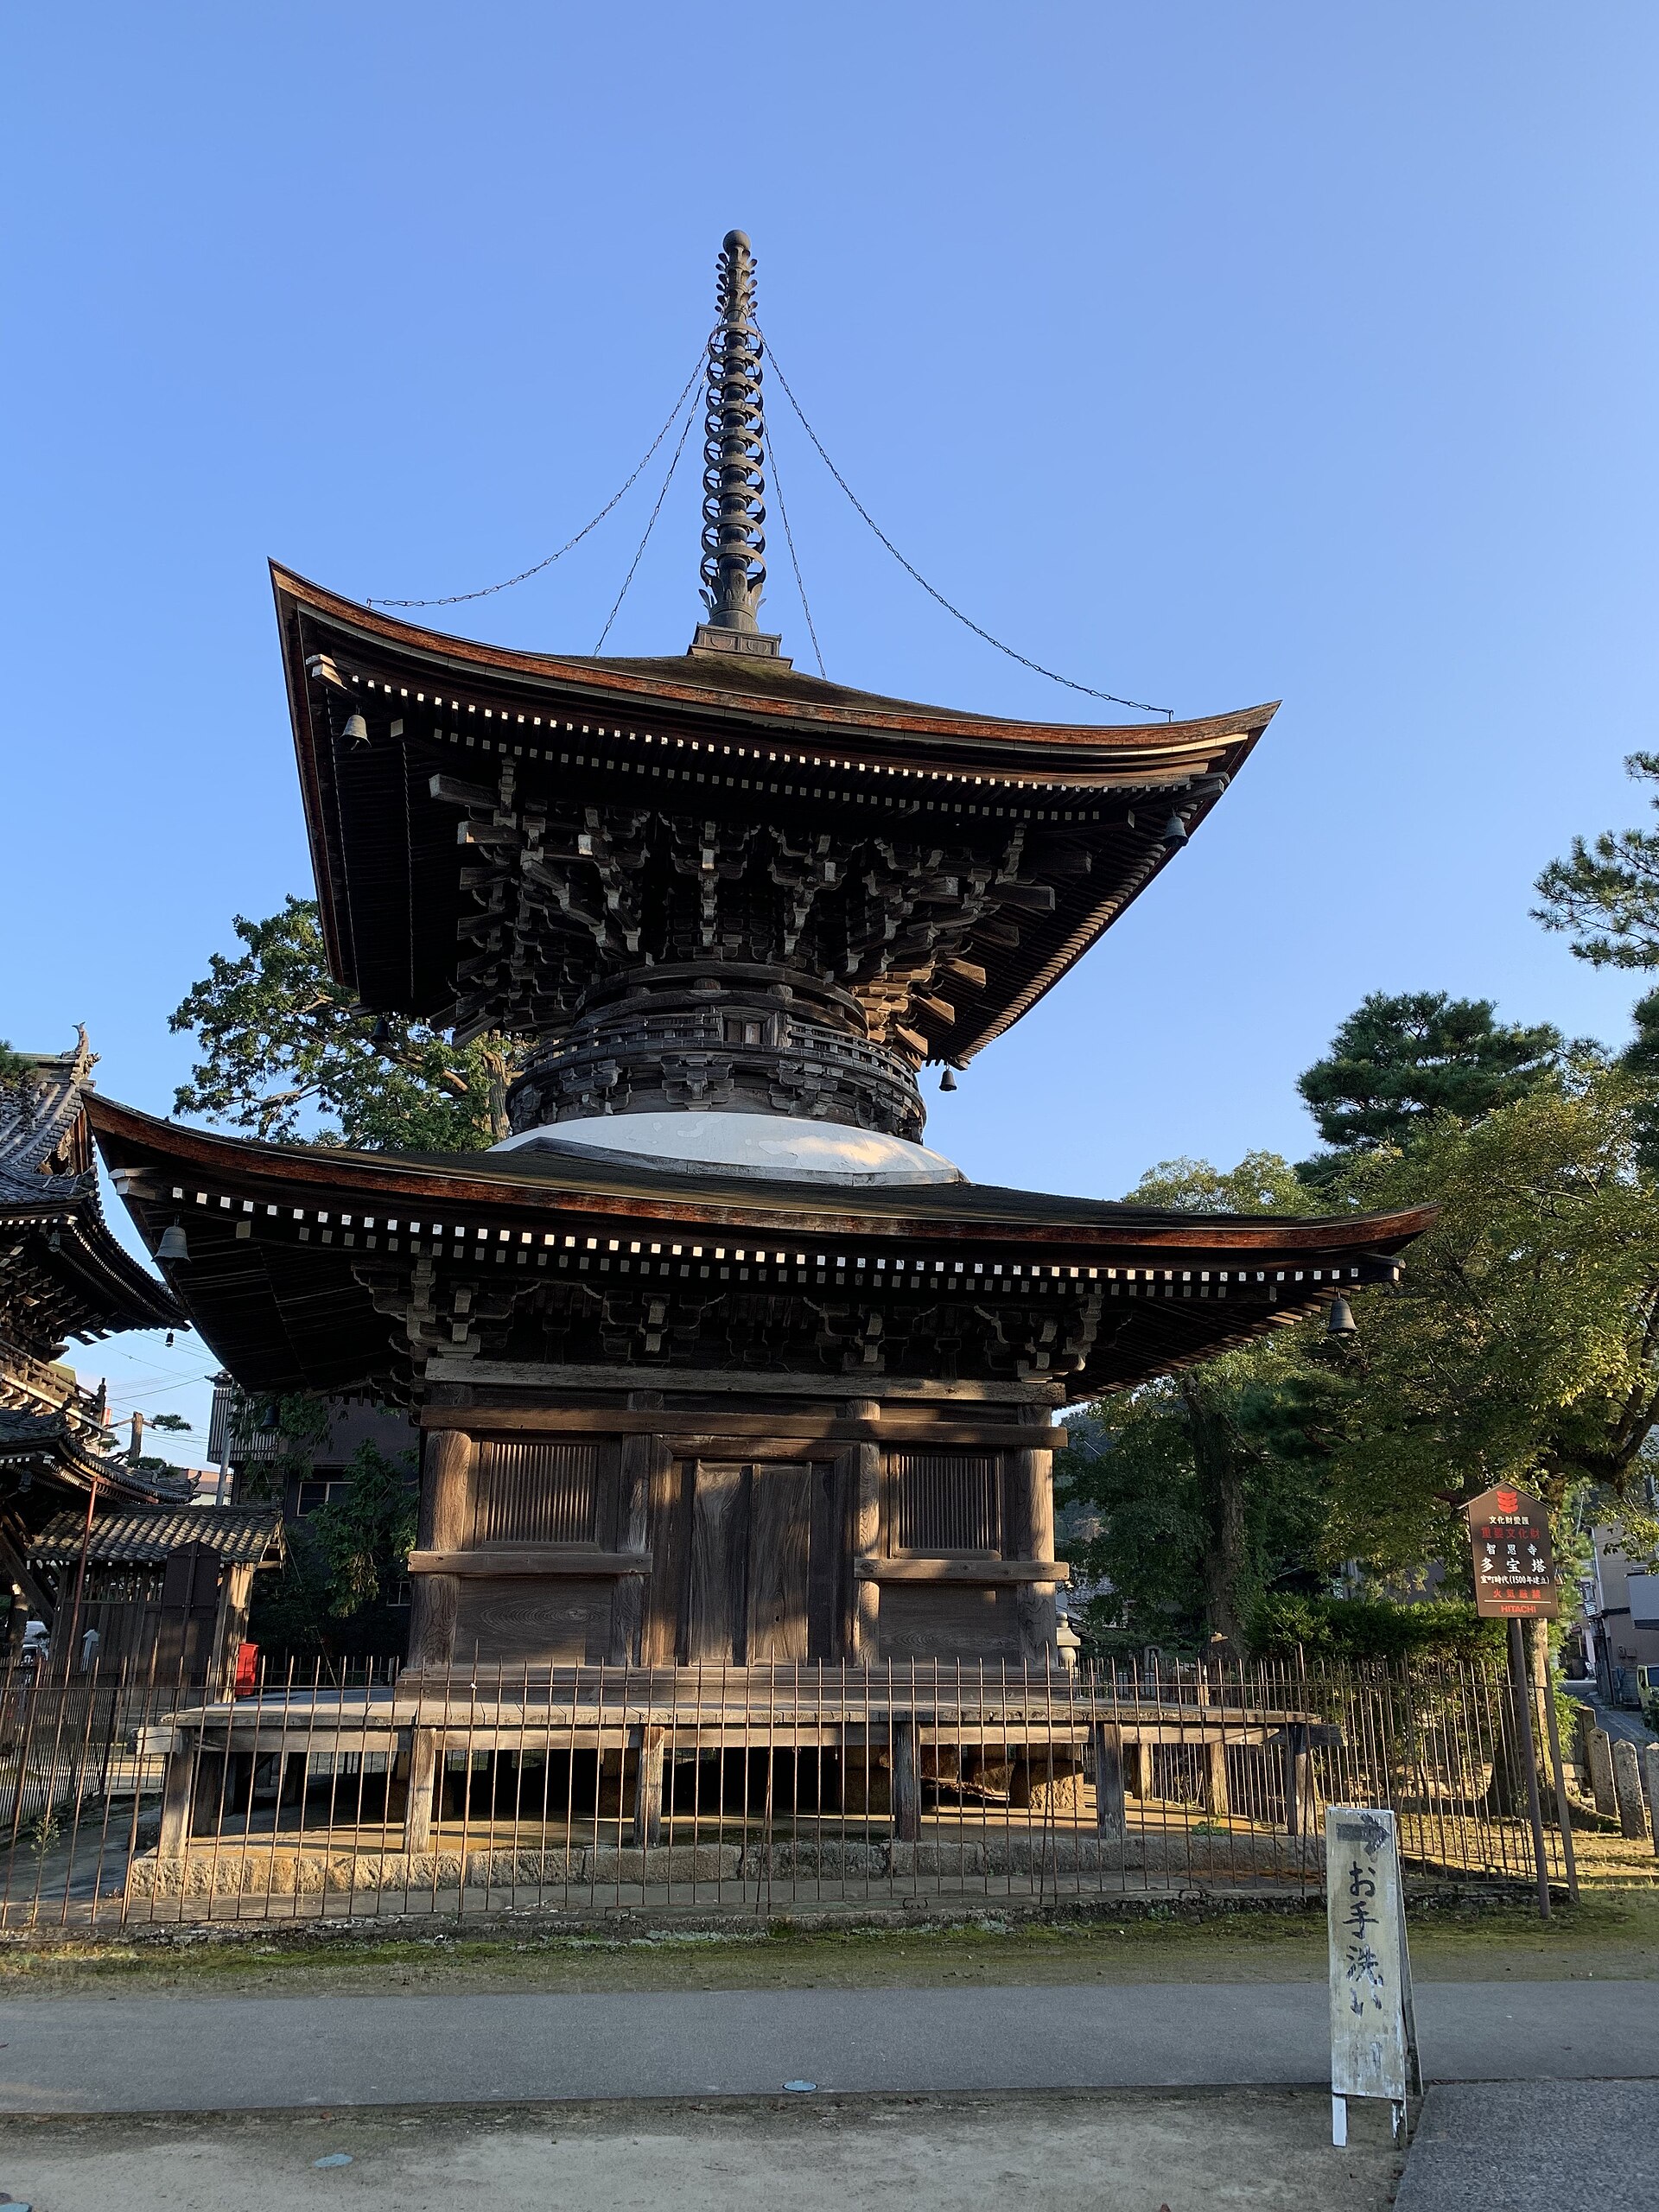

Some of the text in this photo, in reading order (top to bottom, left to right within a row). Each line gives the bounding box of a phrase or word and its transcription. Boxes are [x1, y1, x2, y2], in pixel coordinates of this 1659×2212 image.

[1481, 1527, 1541, 1539] 重要文化財
[1486, 1542, 1538, 1556] 智恩寺
[1480, 1557, 1547, 1573] 多宝塔
[1500, 1605, 1536, 1613] HITACHI
[1342, 1860, 1384, 2018] お手洗い
